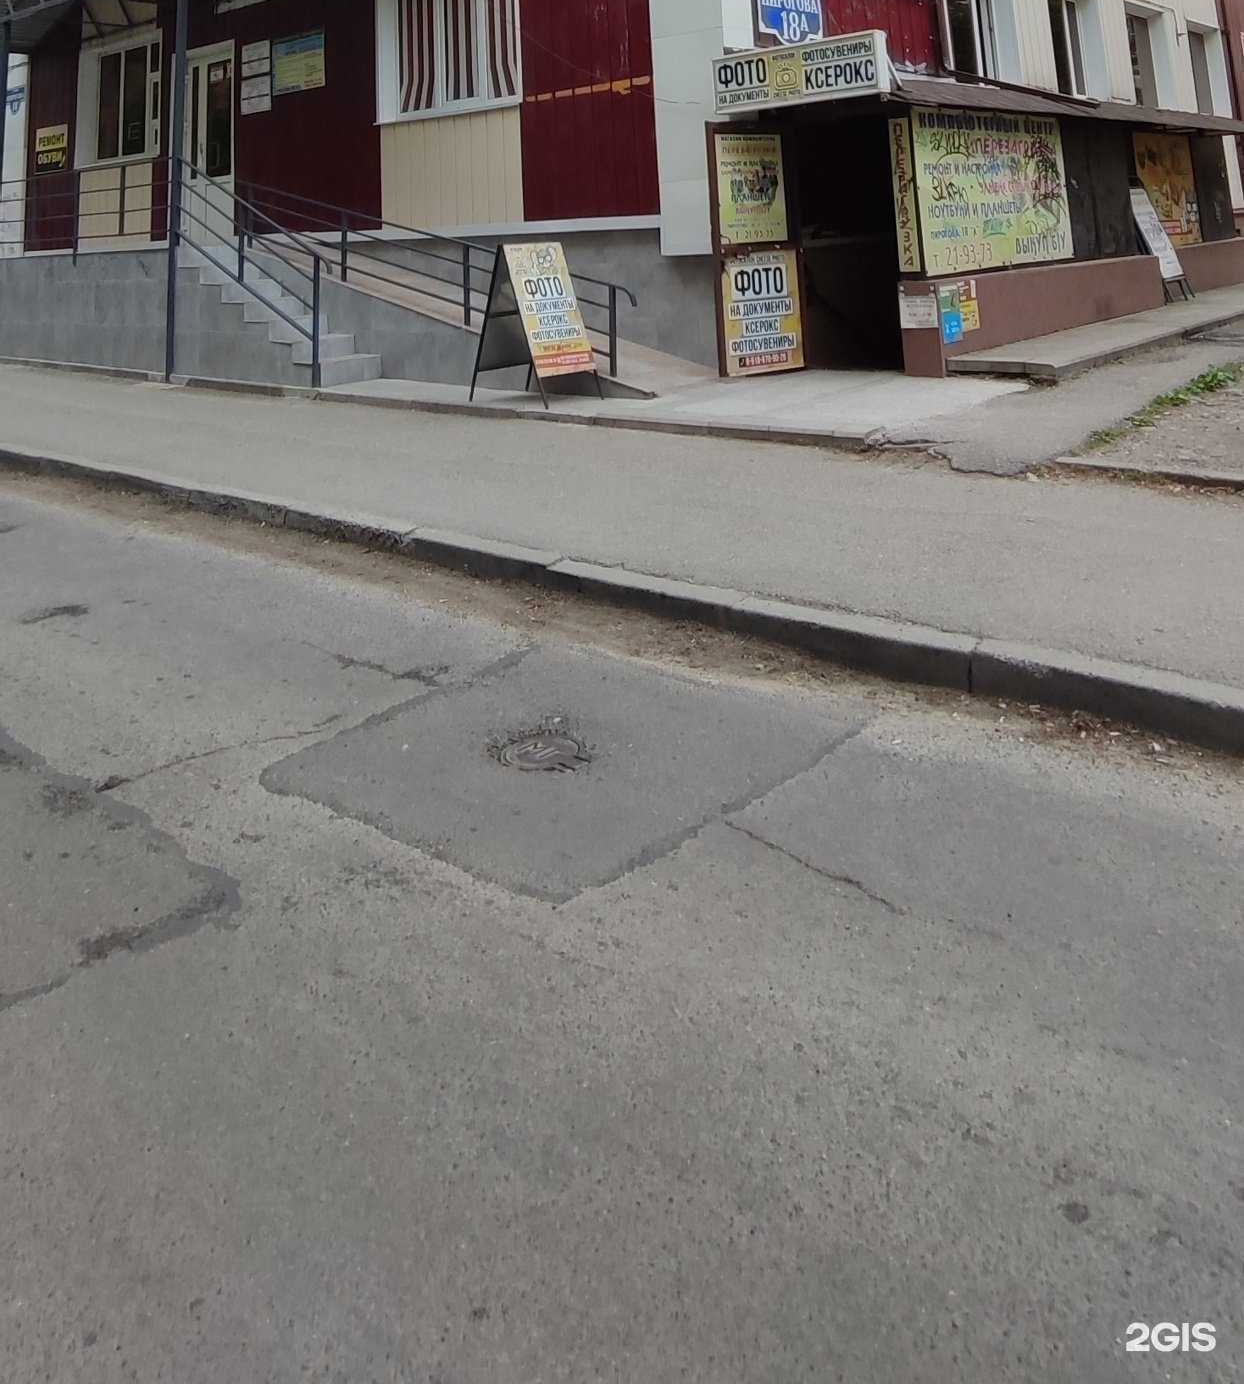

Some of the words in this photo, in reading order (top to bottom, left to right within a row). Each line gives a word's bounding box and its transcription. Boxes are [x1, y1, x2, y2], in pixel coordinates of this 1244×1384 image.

[801, 40, 872, 62] ФОТОСУВЕНИРЫ
[718, 57, 767, 88] ФОТО
[804, 59, 875, 91] КСЕРОКС
[719, 95, 728, 105] НА
[729, 89, 769, 104] ДОКУМЕНТЫ
[38, 133, 65, 147] РЕМОНТ
[922, 162, 952, 176] РЕМОНТ
[928, 202, 970, 219] НОУТБУКИ
[973, 203, 979, 217] И
[980, 200, 1021, 218] ПЛАНШЕТЫ
[945, 242, 993, 267] 21-93-73
[1015, 235, 1049, 255] ВЫКУП
[524, 276, 564, 298] ФОТО
[734, 266, 785, 296] ФОТО
[525, 302, 535, 313] НА
[535, 299, 574, 313] ДОКУМЕНТЫ
[730, 304, 741, 317] НА
[743, 300, 792, 317] ДОКУМЕНТЫ
[538, 314, 568, 326] КСЕРОКС
[745, 318, 779, 335] КСЕРОКС
[531, 327, 582, 341] ФОТОСУВЕНИРЫ
[731, 334, 795, 353] ФОТОСУВЕНИРЫ
